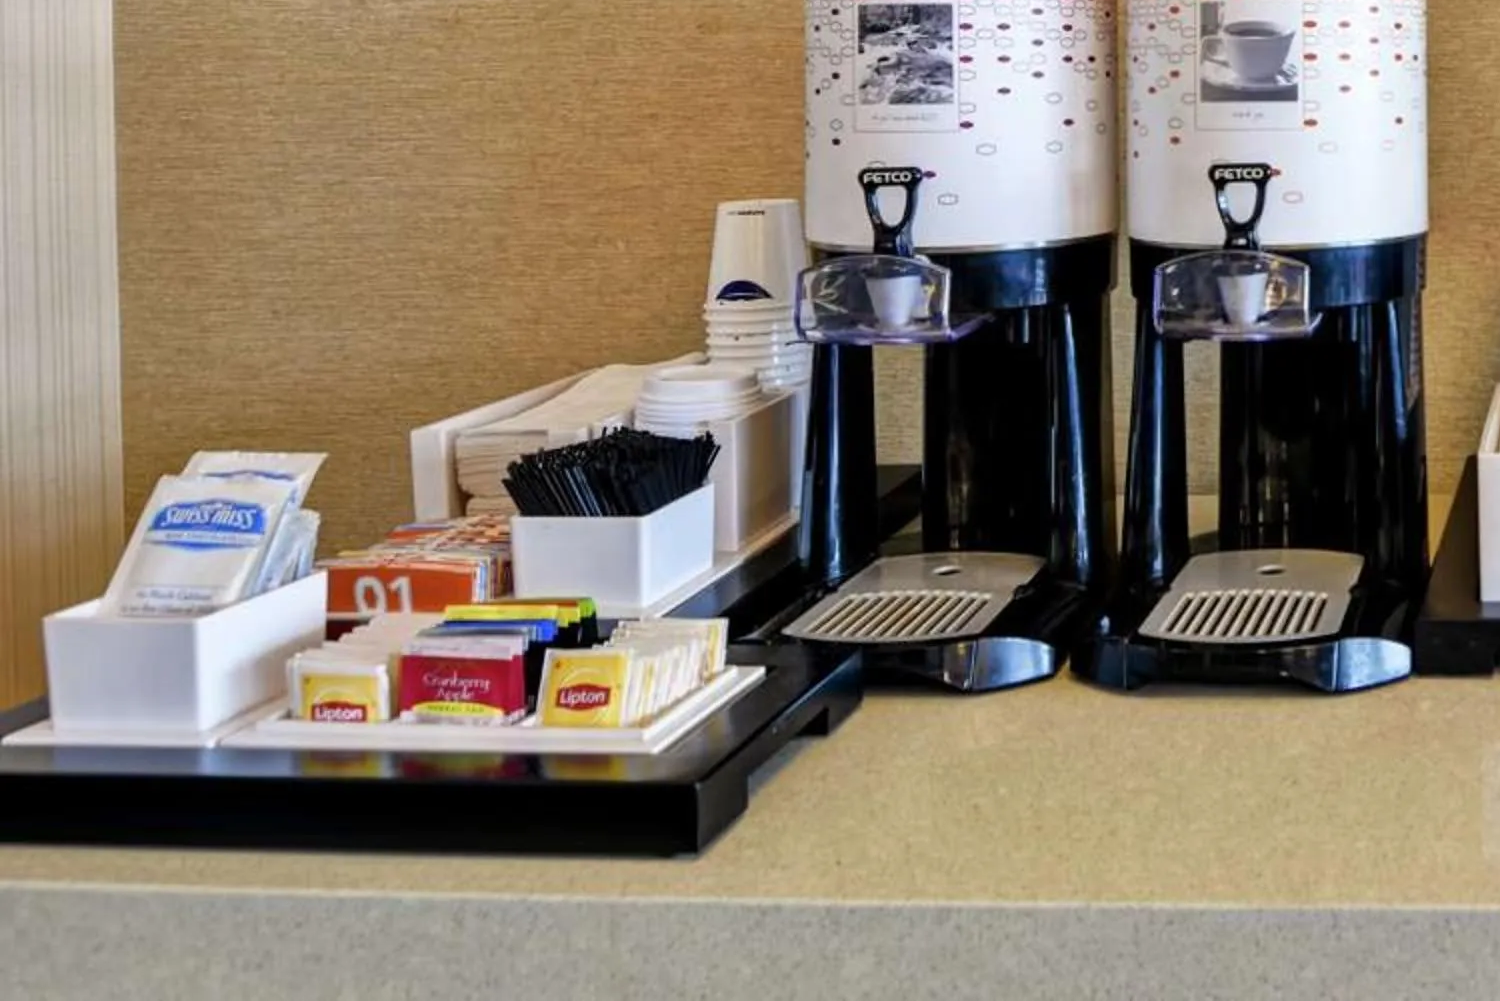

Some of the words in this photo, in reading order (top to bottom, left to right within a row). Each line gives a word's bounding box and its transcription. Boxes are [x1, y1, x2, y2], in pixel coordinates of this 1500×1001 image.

[863, 172, 913, 184] FETCO
[1214, 167, 1265, 179] FETCO
[353, 576, 411, 617] 01
[422, 669, 492, 693] Cranberry
[560, 689, 606, 708] Lipton
[315, 705, 364, 723] Lipton
